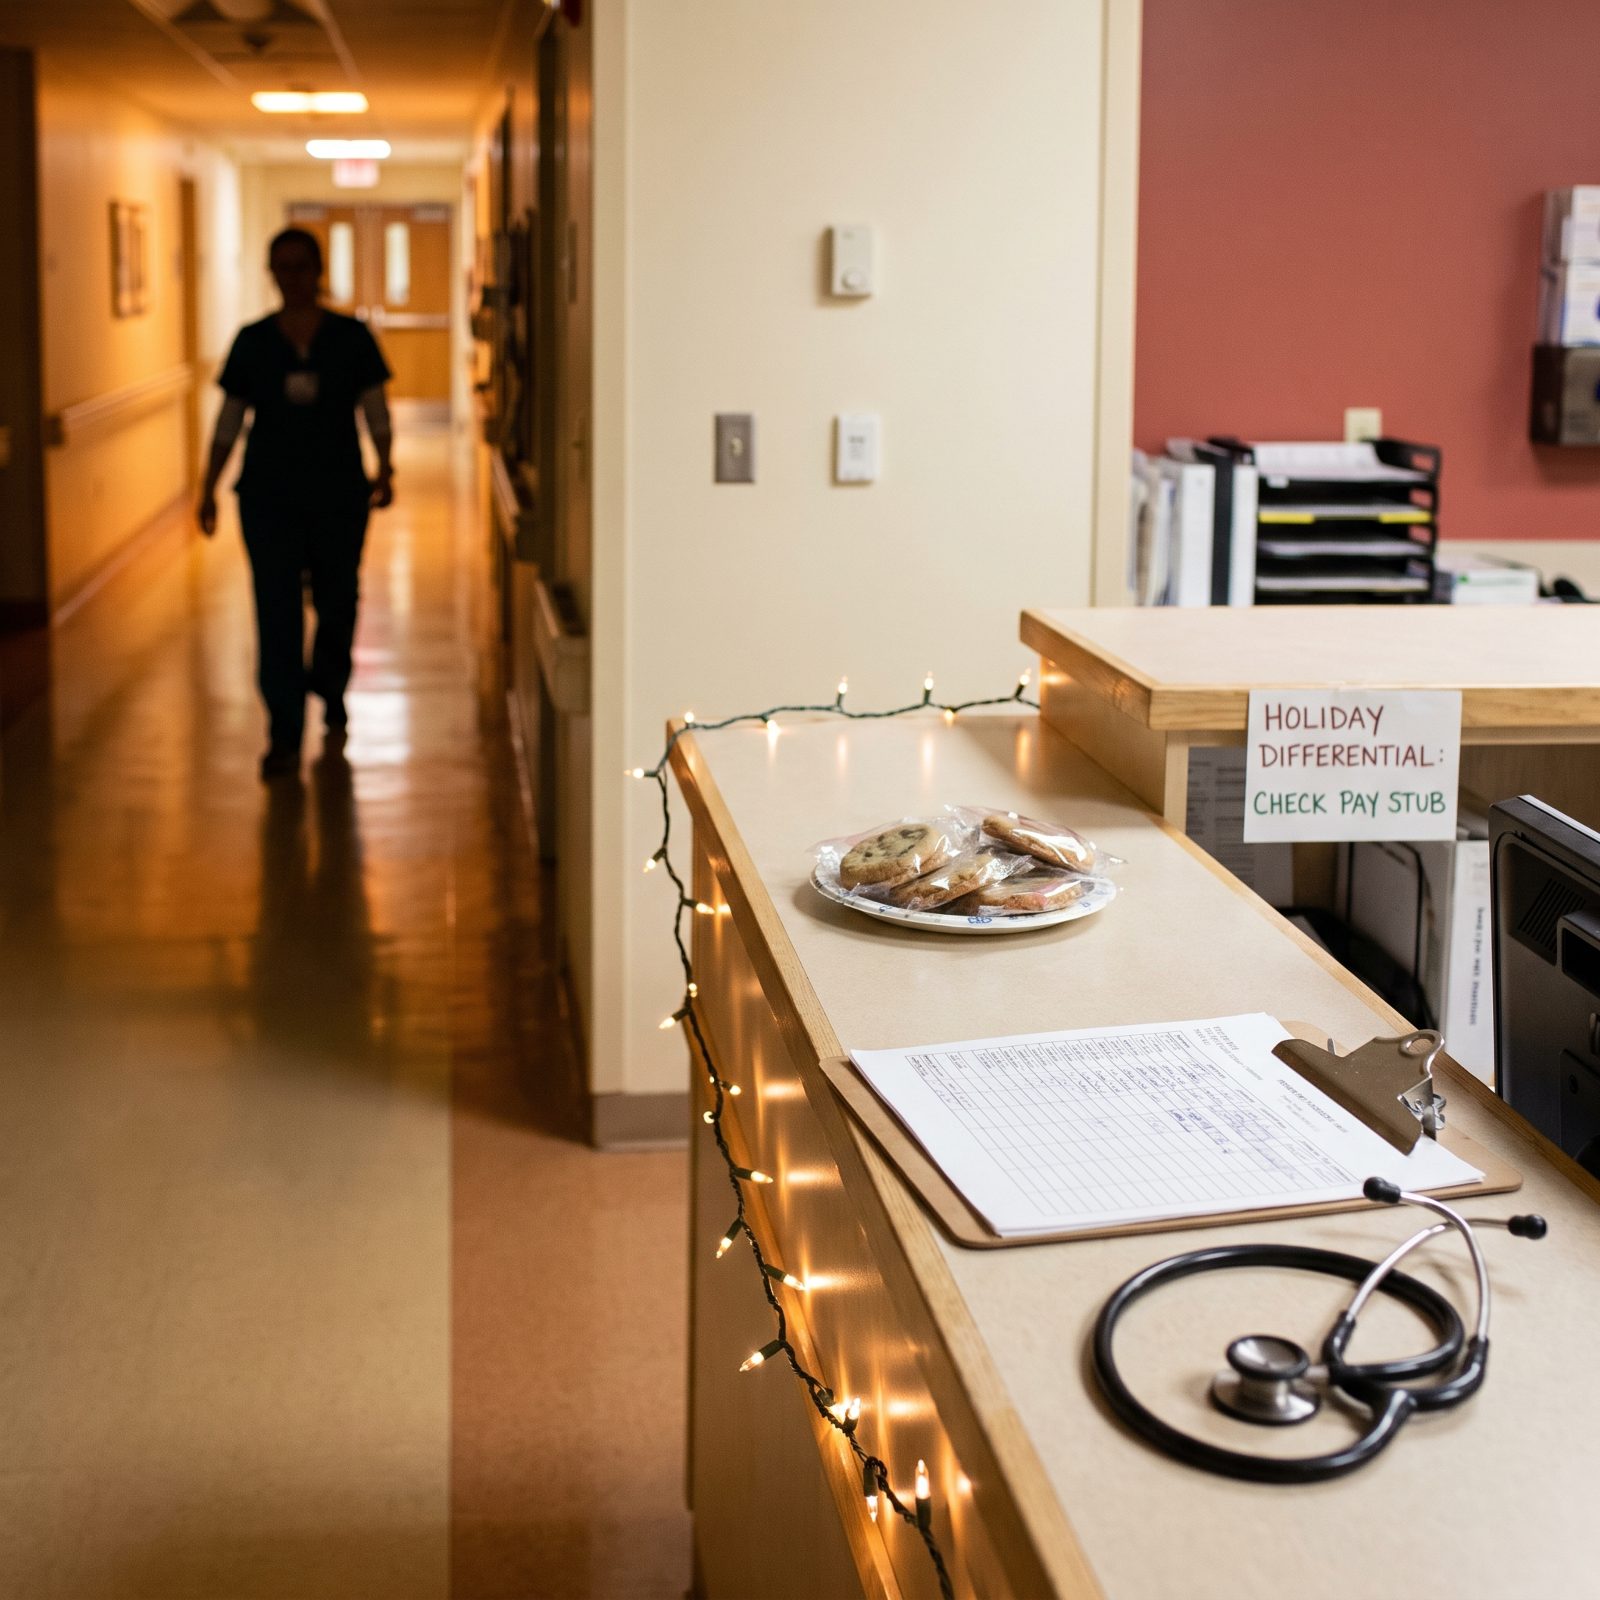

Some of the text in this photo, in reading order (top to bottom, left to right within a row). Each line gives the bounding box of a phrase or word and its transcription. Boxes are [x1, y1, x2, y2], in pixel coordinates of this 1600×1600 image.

[1265, 703, 1384, 736] HOLIDAY
[1259, 744, 1444, 768] DIFFERENTIAL:
[1253, 790, 1446, 818] CHECK PAY STUB
